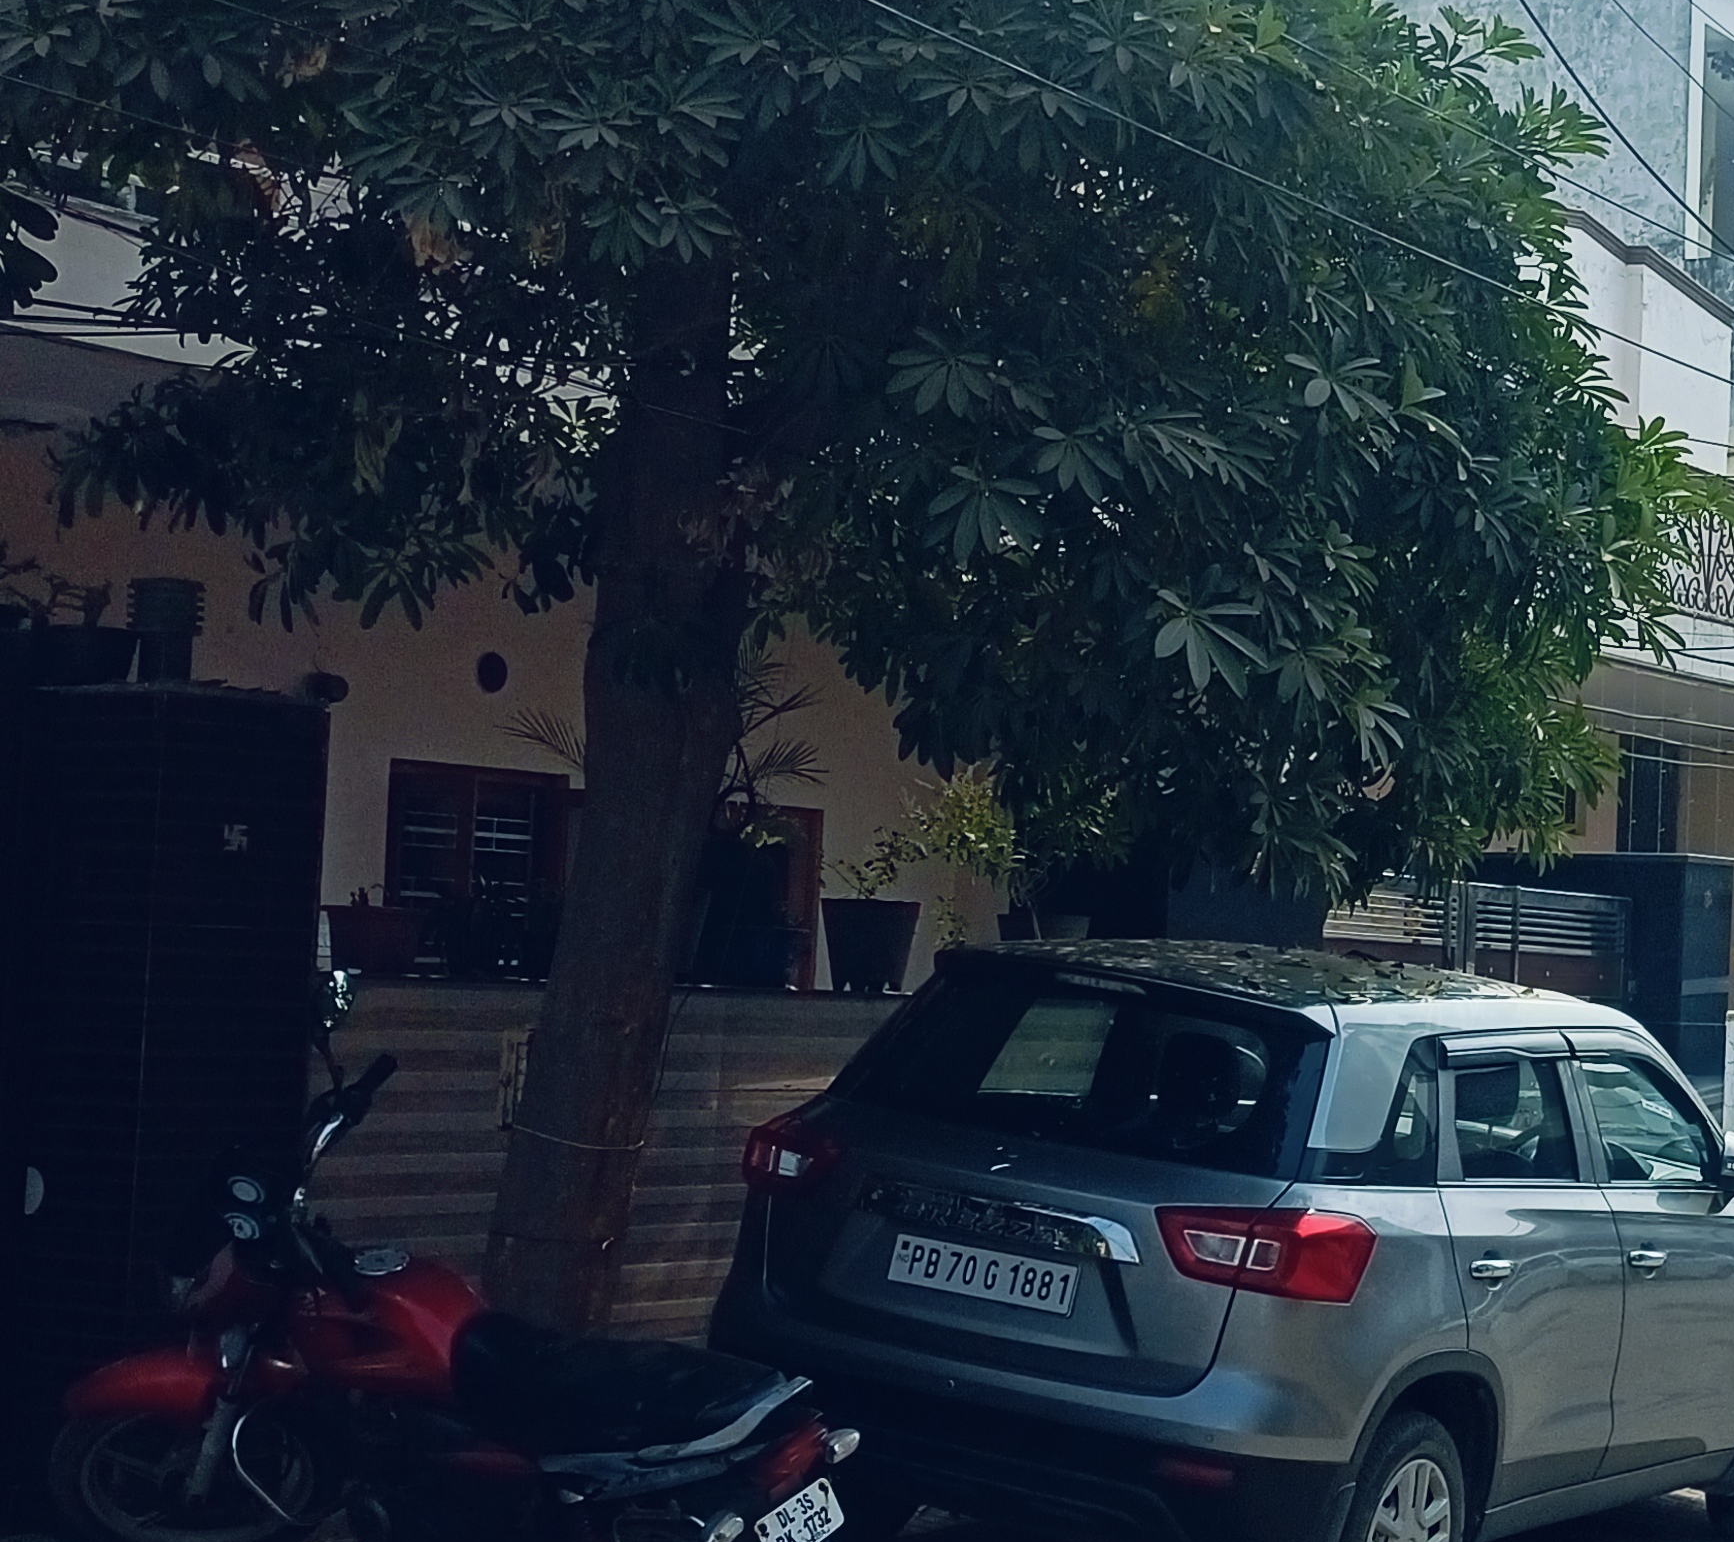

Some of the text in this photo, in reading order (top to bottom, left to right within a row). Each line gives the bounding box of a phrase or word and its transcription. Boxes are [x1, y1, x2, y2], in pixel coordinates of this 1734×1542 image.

[907, 1244, 1071, 1306] PB 70 G 1881
